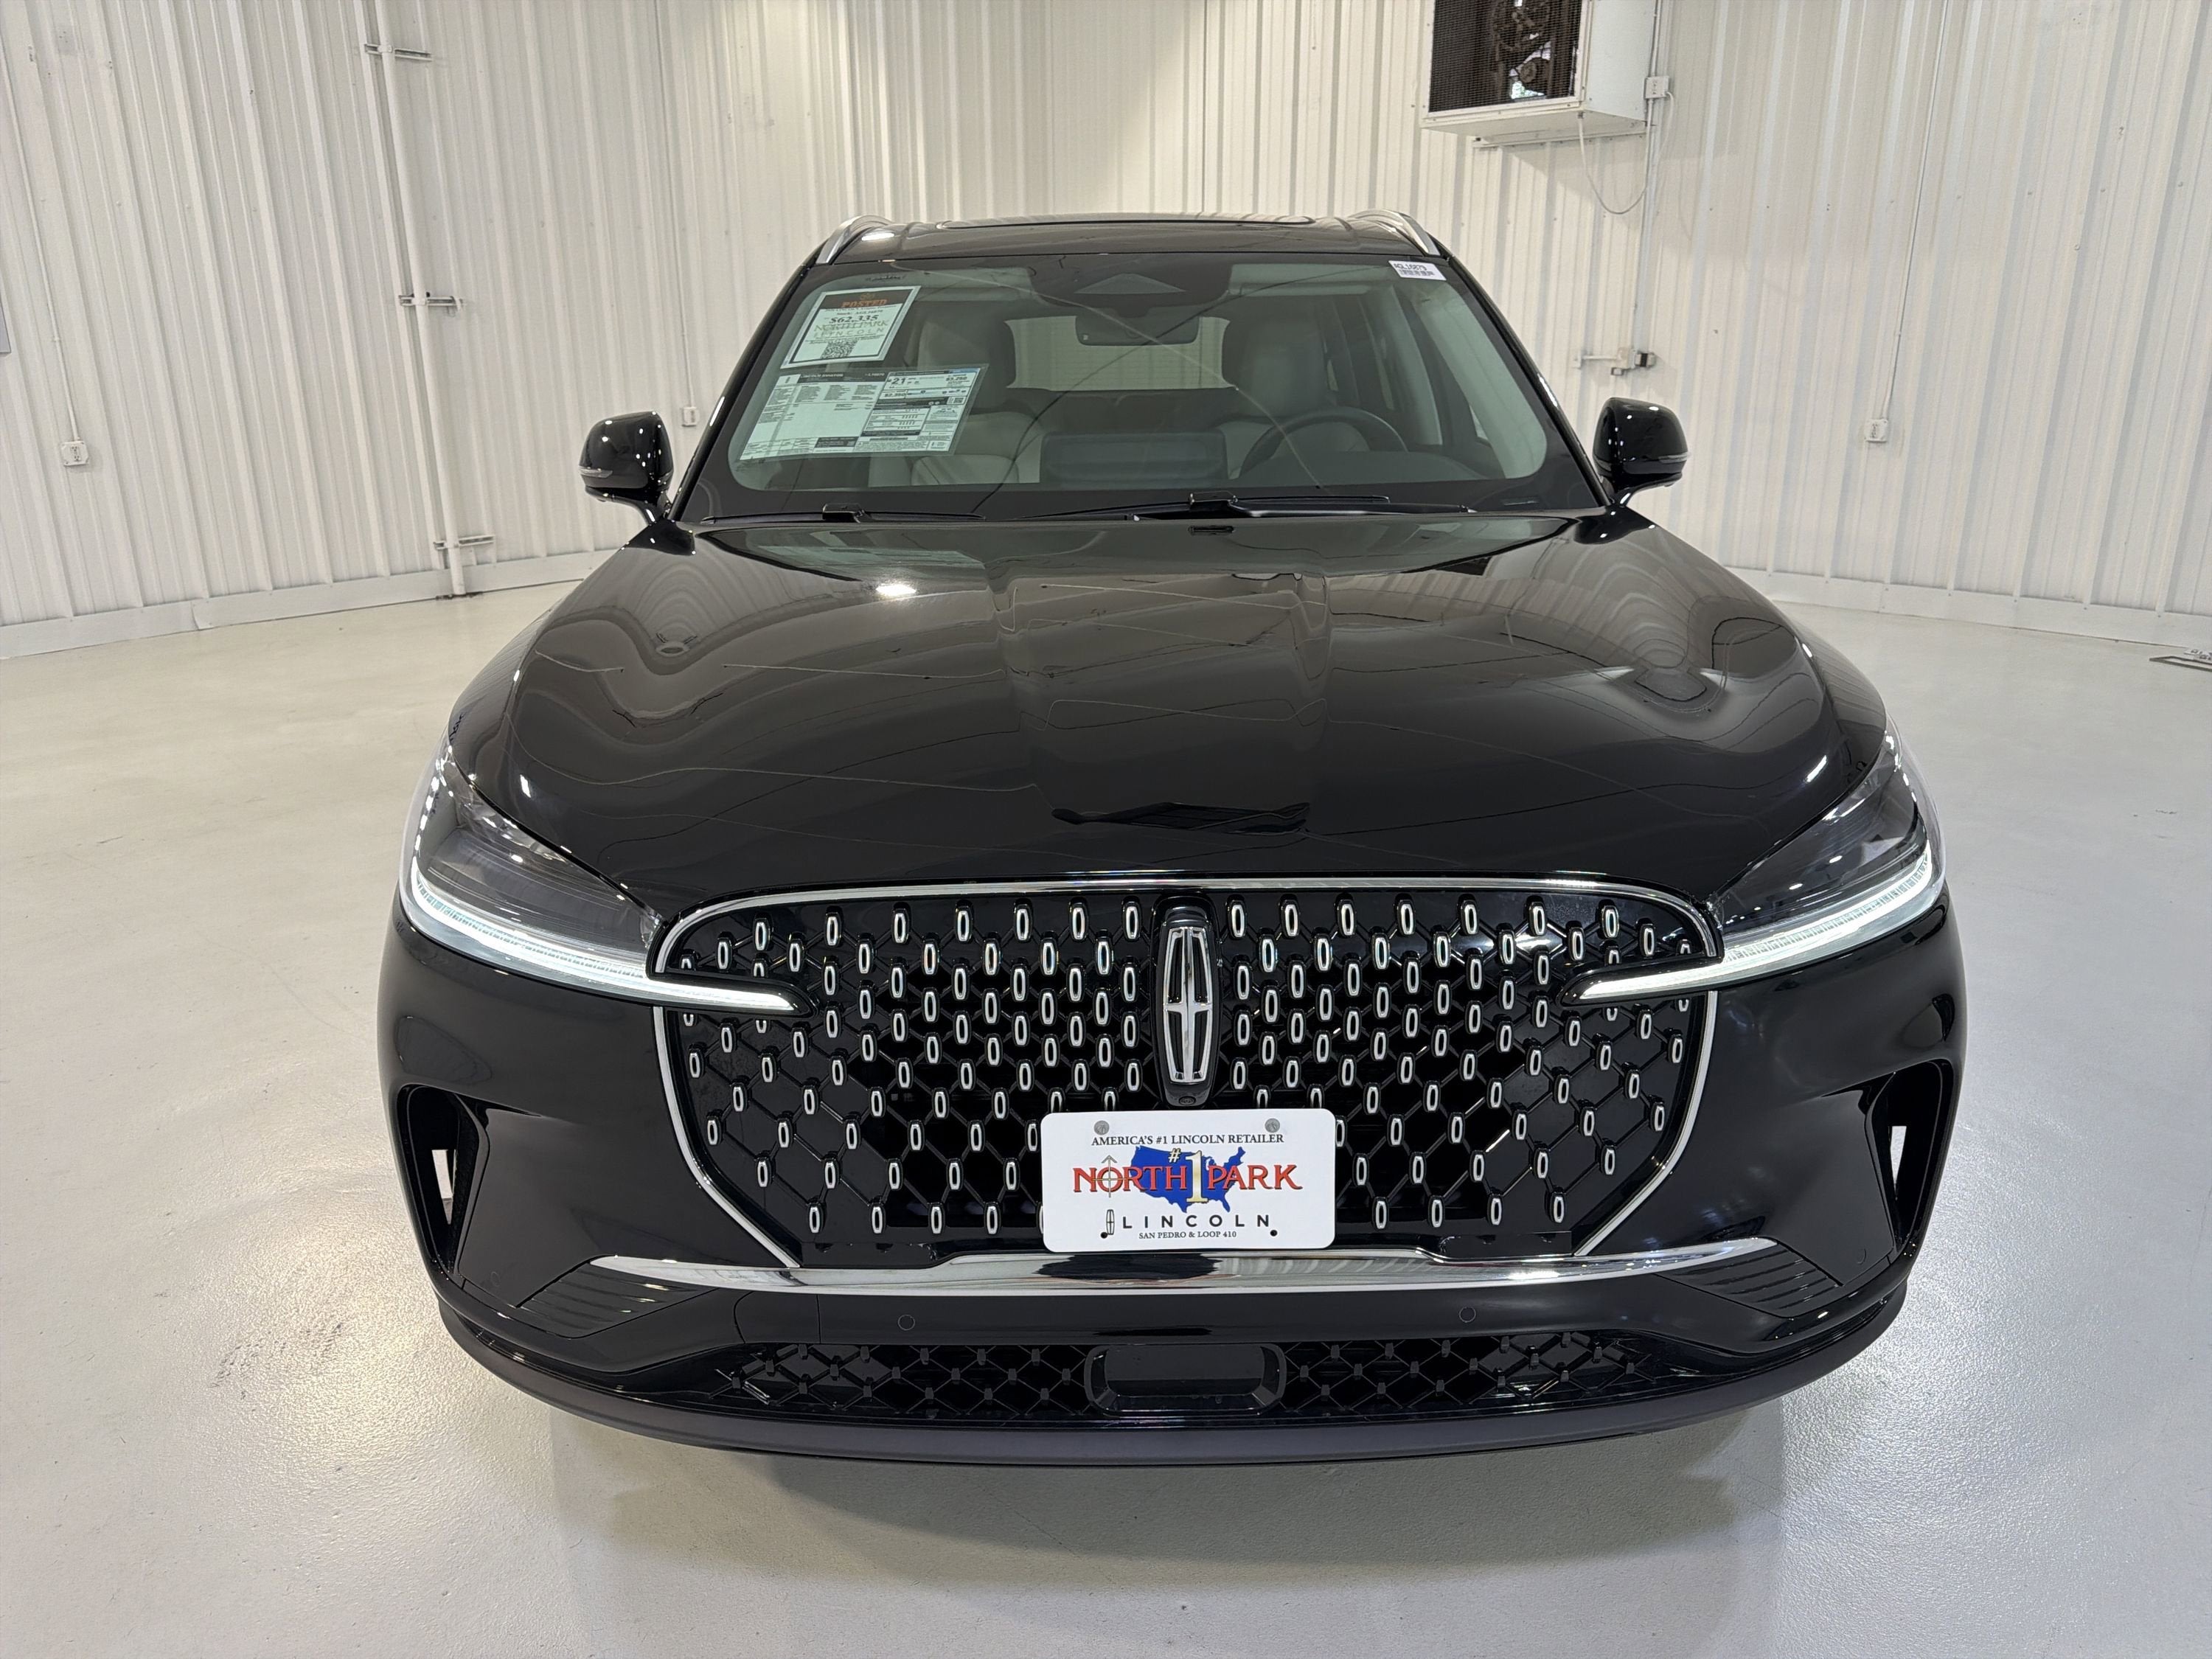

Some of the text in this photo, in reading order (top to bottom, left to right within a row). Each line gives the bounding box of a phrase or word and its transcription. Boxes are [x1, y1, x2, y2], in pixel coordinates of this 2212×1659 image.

[829, 315, 879, 323] $62,335
[1091, 1134, 1284, 1146] AMERICA'S #1 LINCOLN RETAILER
[1073, 1164, 1304, 1193] NORTH PARK
[1122, 1214, 1270, 1229] LINCOLN
[1158, 1231, 1187, 1239] PEDRO
[1197, 1231, 1221, 1239] LOOP
[1222, 1231, 1237, 1239] 410
